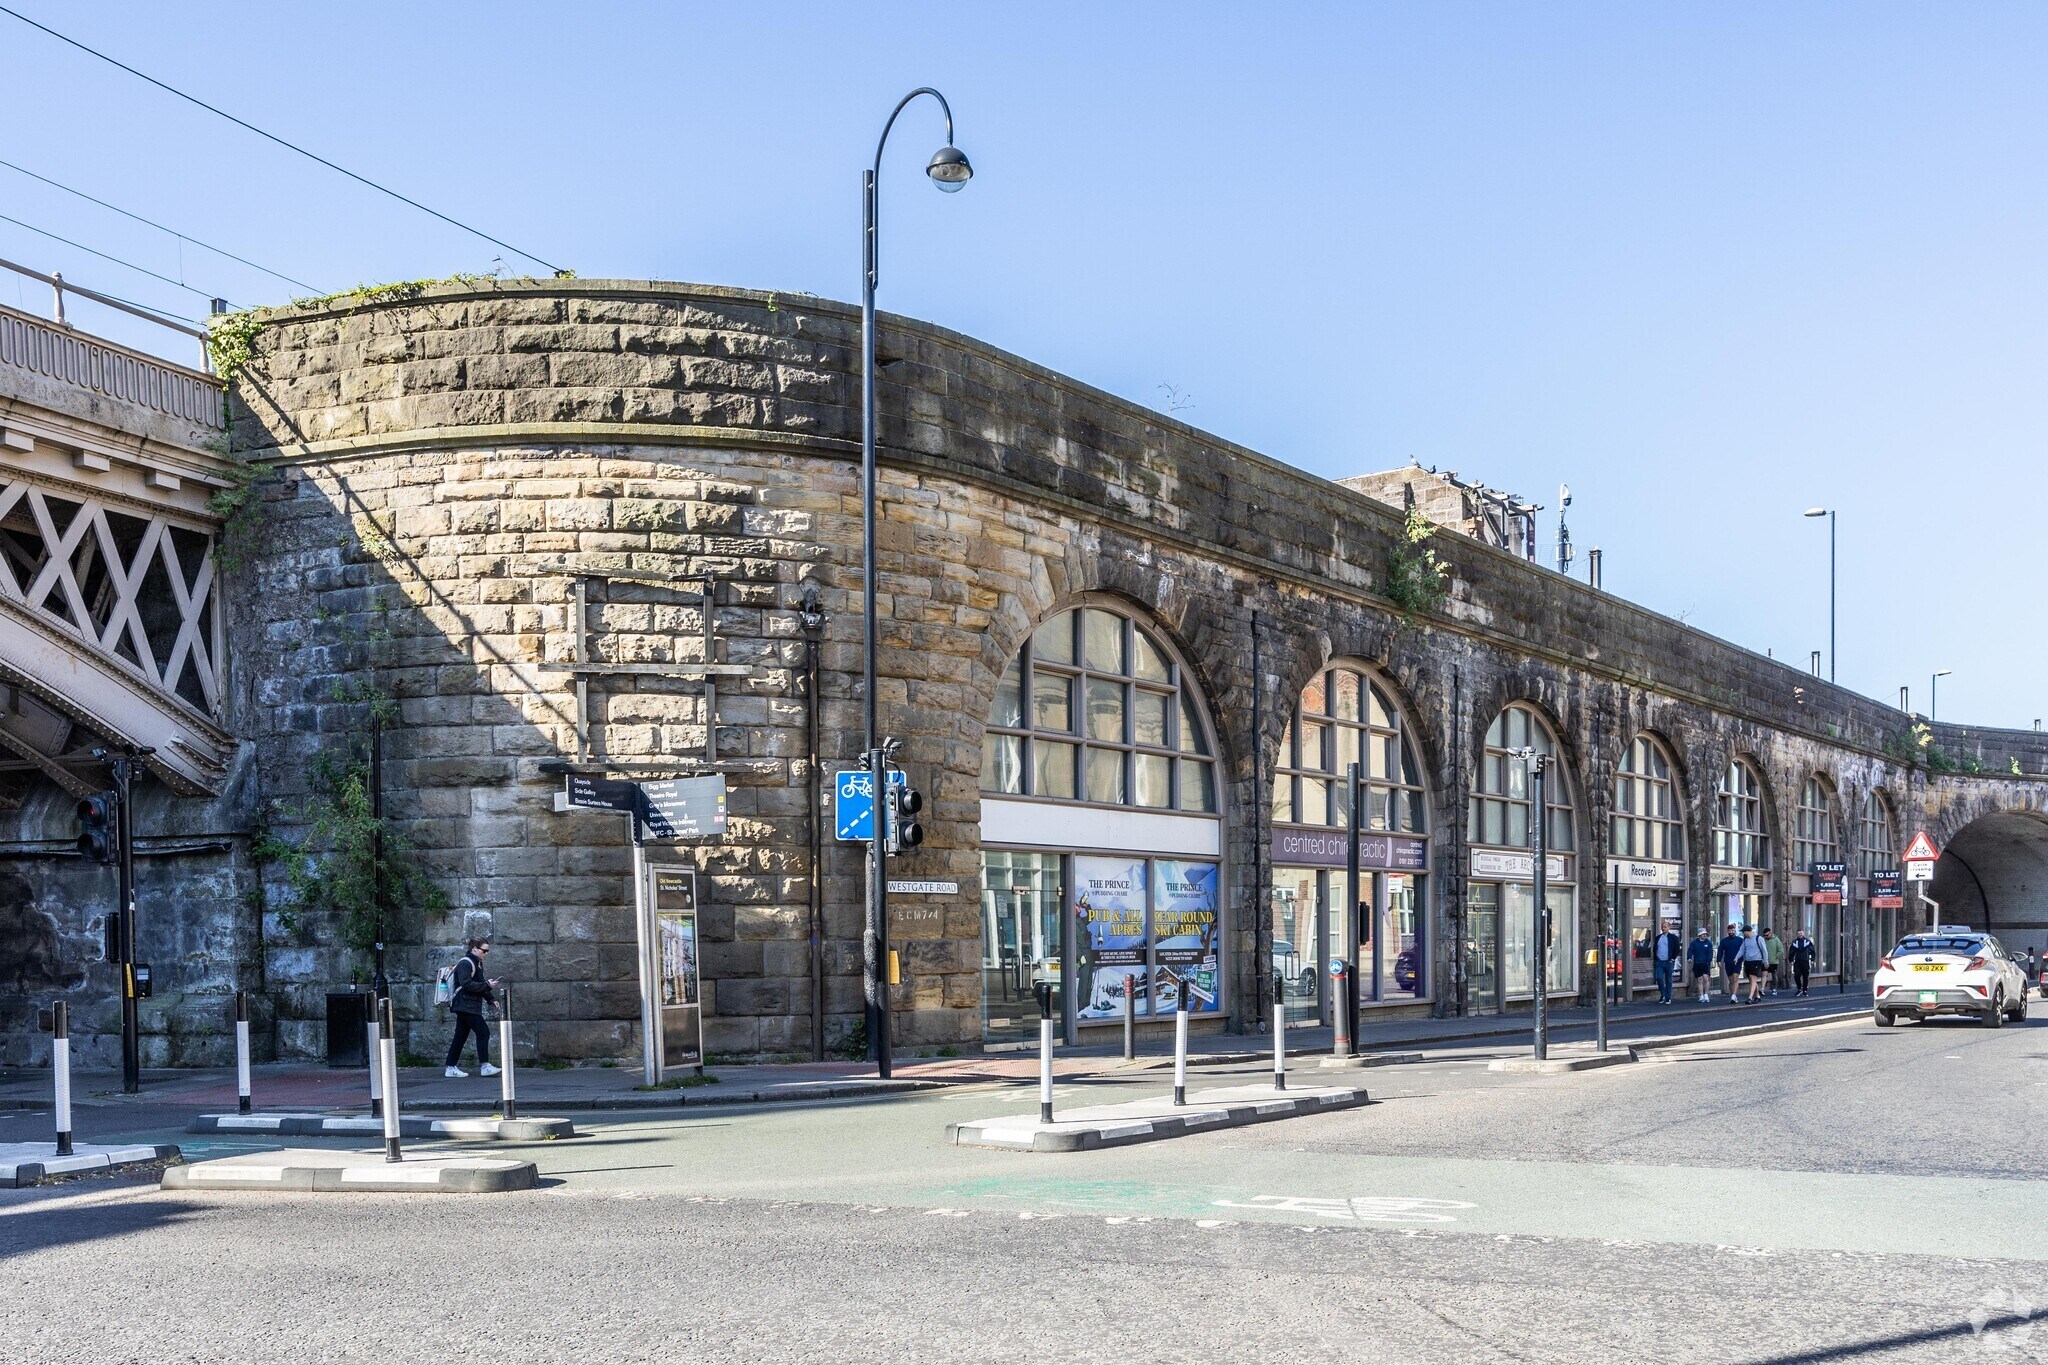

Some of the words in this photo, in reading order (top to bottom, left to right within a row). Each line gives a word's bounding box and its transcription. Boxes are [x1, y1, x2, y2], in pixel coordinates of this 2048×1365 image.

[1284, 836, 1324, 854] centred
[1328, 836, 1385, 858] chirractic
[1505, 859, 1516, 871] THE
[1631, 864, 1656, 877] Recover3
[888, 883, 933, 891] WESTGATE
[937, 884, 956, 892] ROAD
[1089, 880, 1103, 888] THE
[1105, 880, 1129, 889] PRINCE
[1474, 887, 1480, 901] 4
[1088, 909, 1110, 922] PUB
[1112, 909, 1121, 922] &
[1123, 910, 1142, 922] ALL
[1155, 911, 1178, 923] YEAR
[1180, 911, 1212, 923] ROUND
[1155, 924, 1171, 936] SKI
[1173, 924, 1201, 936] CABIN
